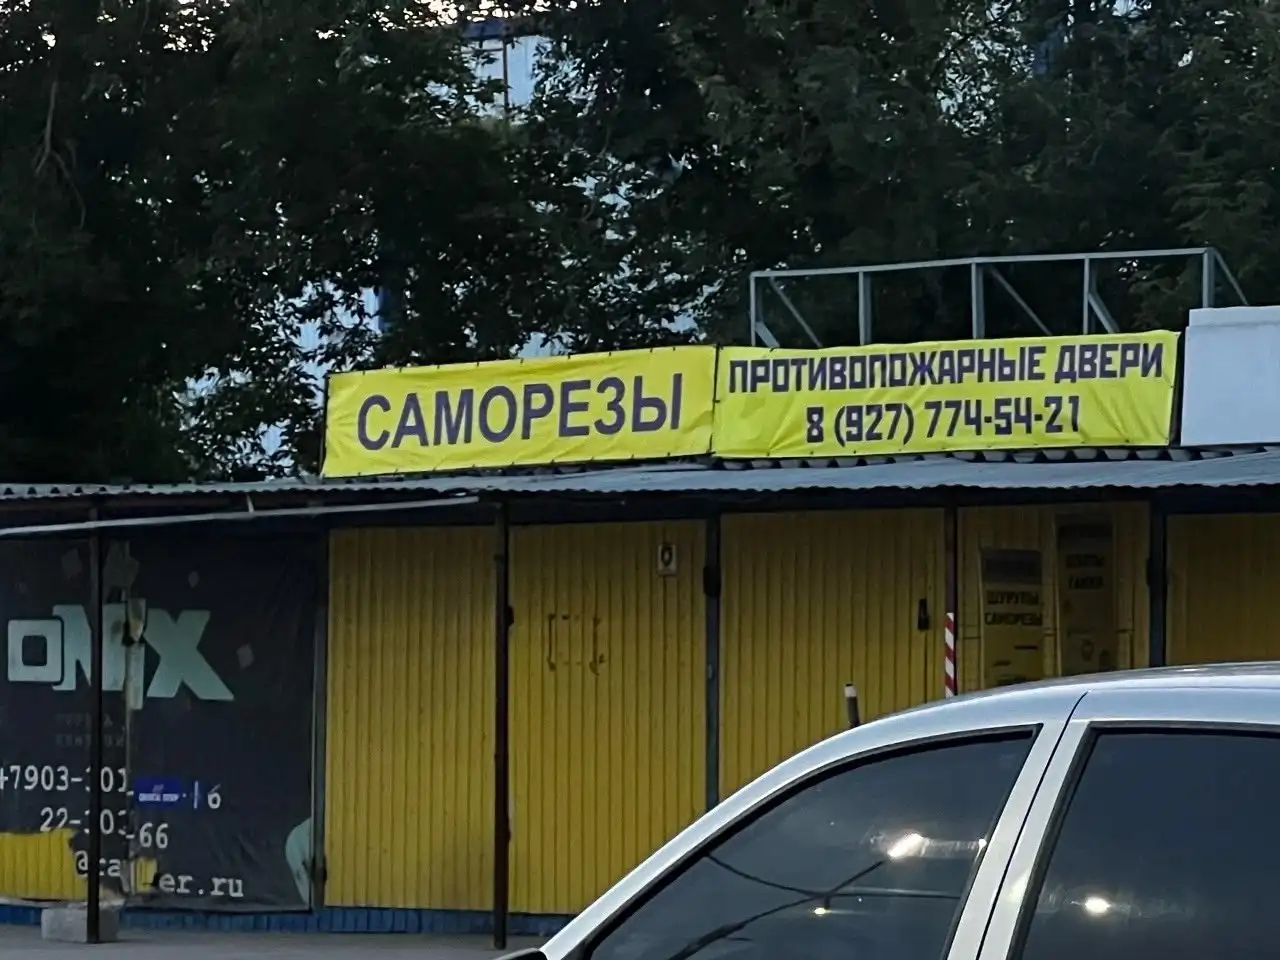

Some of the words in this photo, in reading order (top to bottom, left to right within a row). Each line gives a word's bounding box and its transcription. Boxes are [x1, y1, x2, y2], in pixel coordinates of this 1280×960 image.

[729, 346, 1047, 393] ПРОТИВОПОЖАРНЫЕ
[1054, 343, 1164, 384] ДВЕРИ
[357, 373, 683, 450] САМОРЕЗЫ
[806, 406, 825, 443] 8
[834, 402, 914, 447] (927)
[925, 396, 1080, 438] 774-54-21
